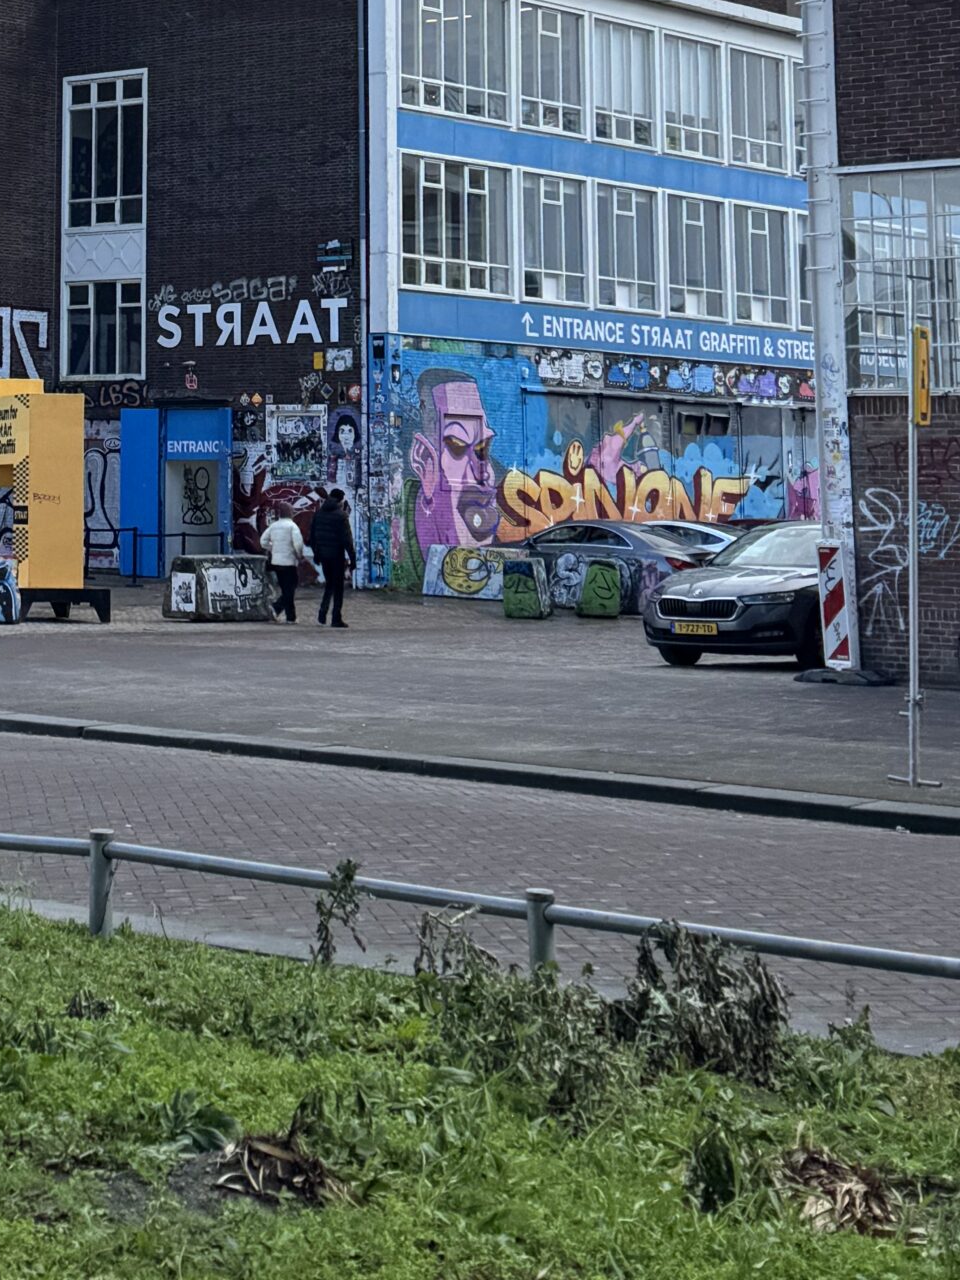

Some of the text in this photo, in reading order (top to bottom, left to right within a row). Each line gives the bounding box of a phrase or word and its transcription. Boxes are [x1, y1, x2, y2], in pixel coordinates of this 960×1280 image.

[156, 297, 348, 349] STRAAT
[542, 315, 625, 344] ENTRANCE
[631, 326, 694, 351] STRAAT
[699, 331, 761, 357] GRAFFITI
[763, 339, 775, 358] &
[10, 404, 18, 420] for
[3, 422, 12, 438] Art
[167, 439, 224, 453] ENTRANC
